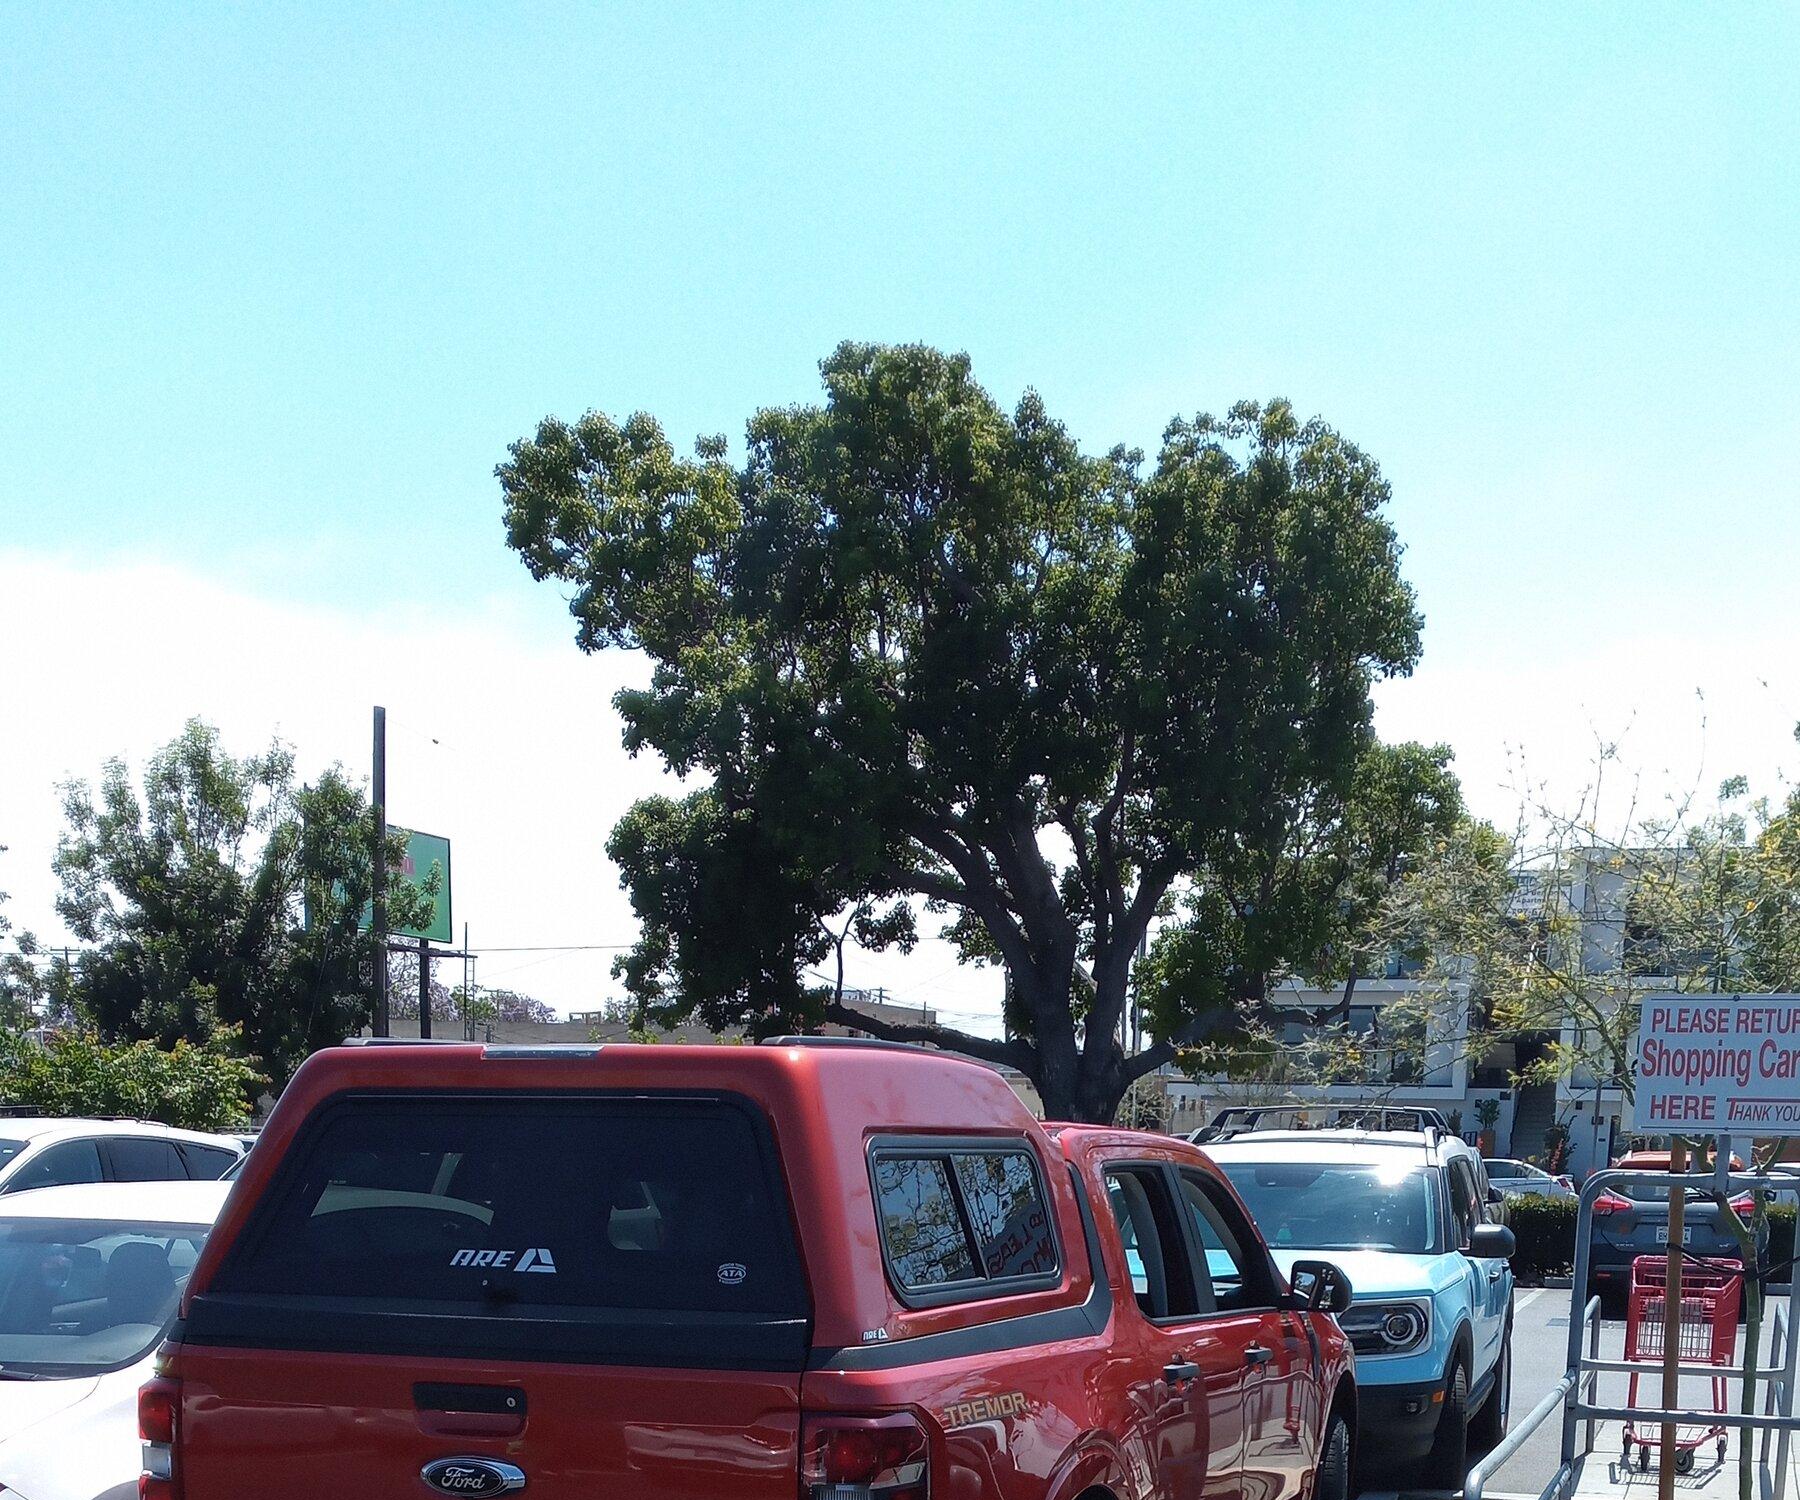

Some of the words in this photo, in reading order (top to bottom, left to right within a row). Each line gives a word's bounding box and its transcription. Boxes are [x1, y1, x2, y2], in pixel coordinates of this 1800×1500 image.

[1651, 1008, 1730, 1034] PLEASE
[1640, 1038, 1752, 1087] Shopping
[1759, 1038, 1800, 1079] Car
[1650, 1094, 1716, 1121] HERE
[1726, 1098, 1773, 1121] THANK
[1775, 1105, 1800, 1122] YOU
[944, 1392, 1028, 1427] TREMOR
[441, 1466, 486, 1489] Ford
